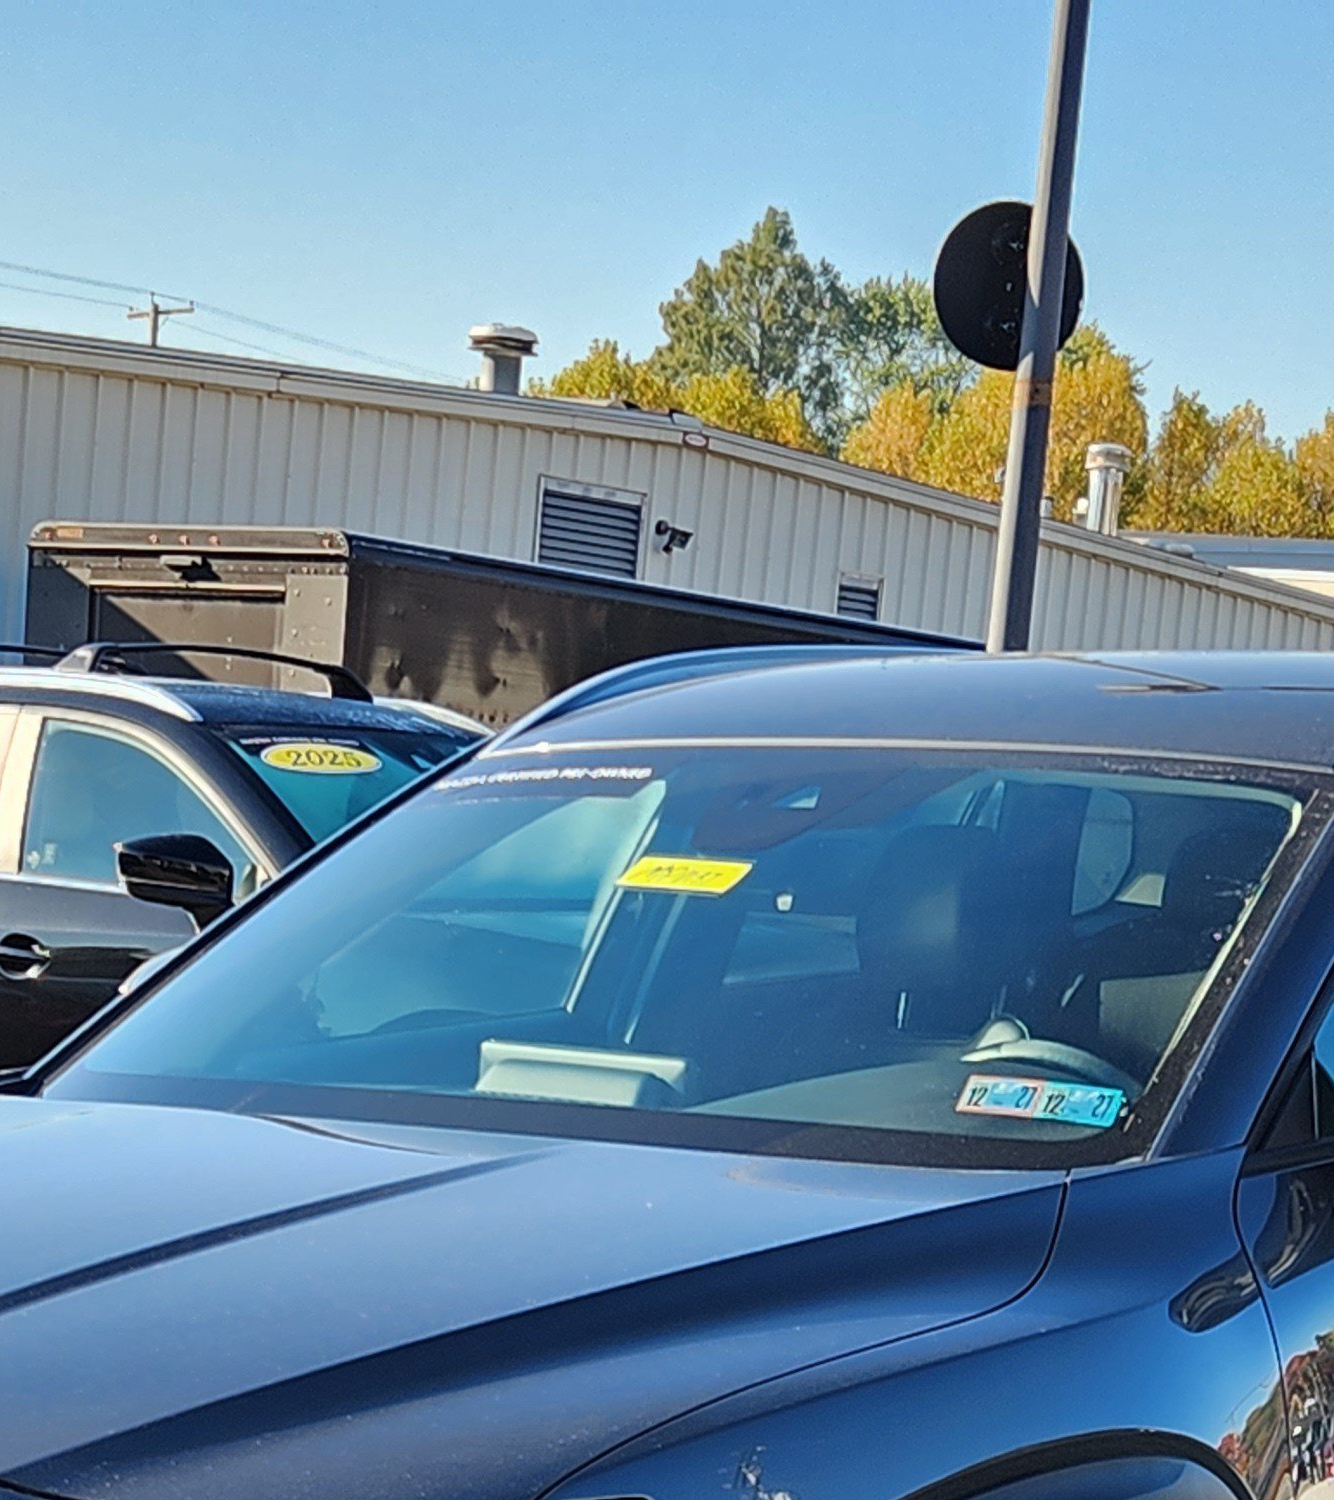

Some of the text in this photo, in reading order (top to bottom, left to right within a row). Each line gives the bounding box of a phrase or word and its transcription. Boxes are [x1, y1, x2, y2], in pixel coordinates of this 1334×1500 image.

[286, 749, 362, 768] 2025
[968, 1085, 1038, 1109] 12 27
[1042, 1094, 1114, 1118] 12 27
